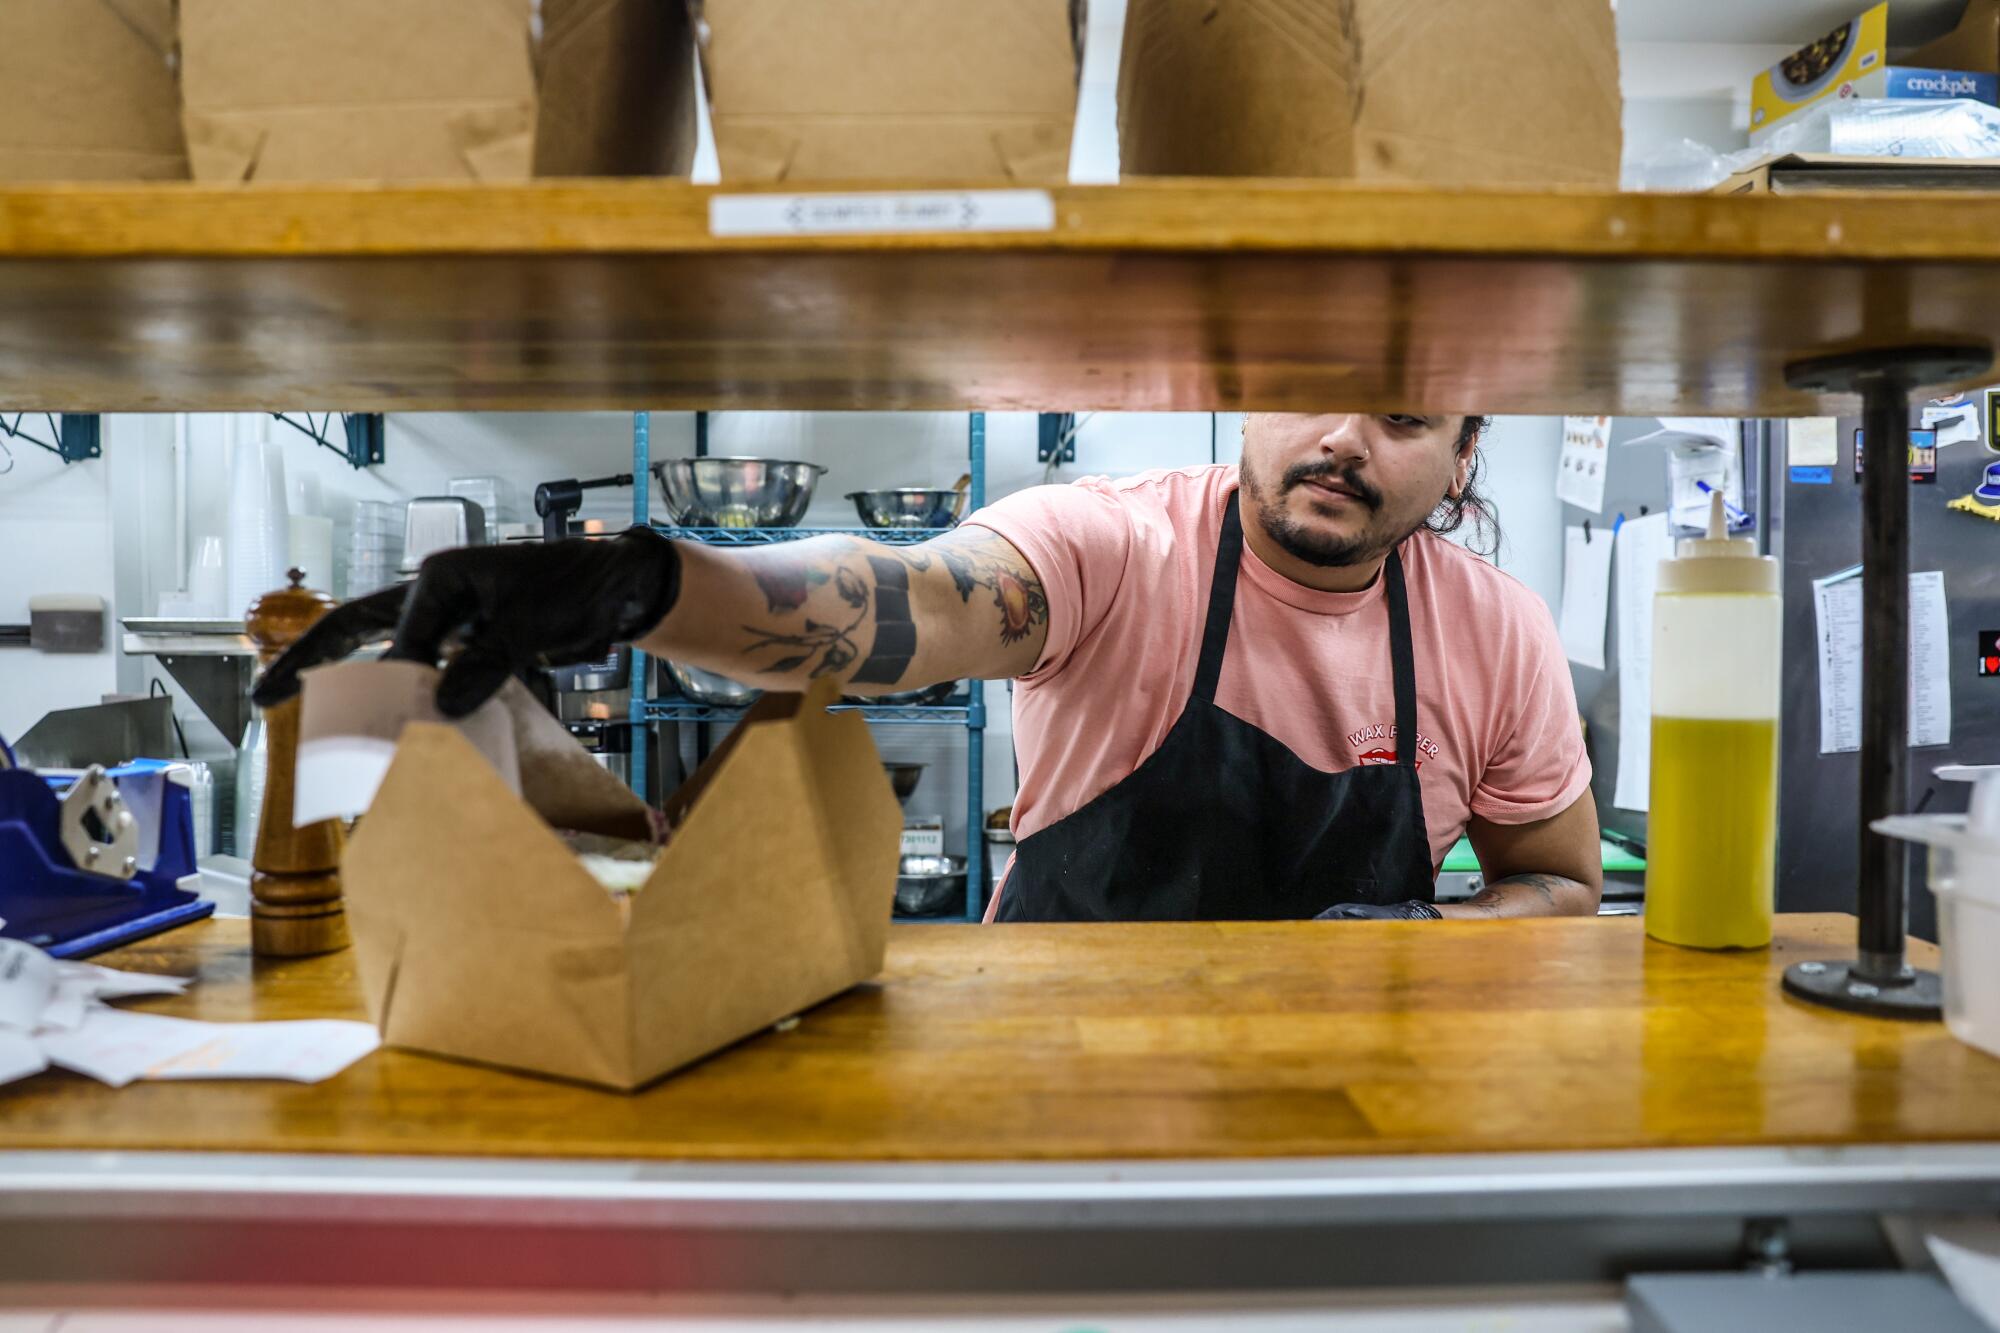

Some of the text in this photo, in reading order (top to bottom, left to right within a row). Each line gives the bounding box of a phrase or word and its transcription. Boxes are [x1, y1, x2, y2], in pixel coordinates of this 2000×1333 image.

[1907, 75, 1977, 97] crockpot
[1348, 724, 1439, 759] WAX PER
